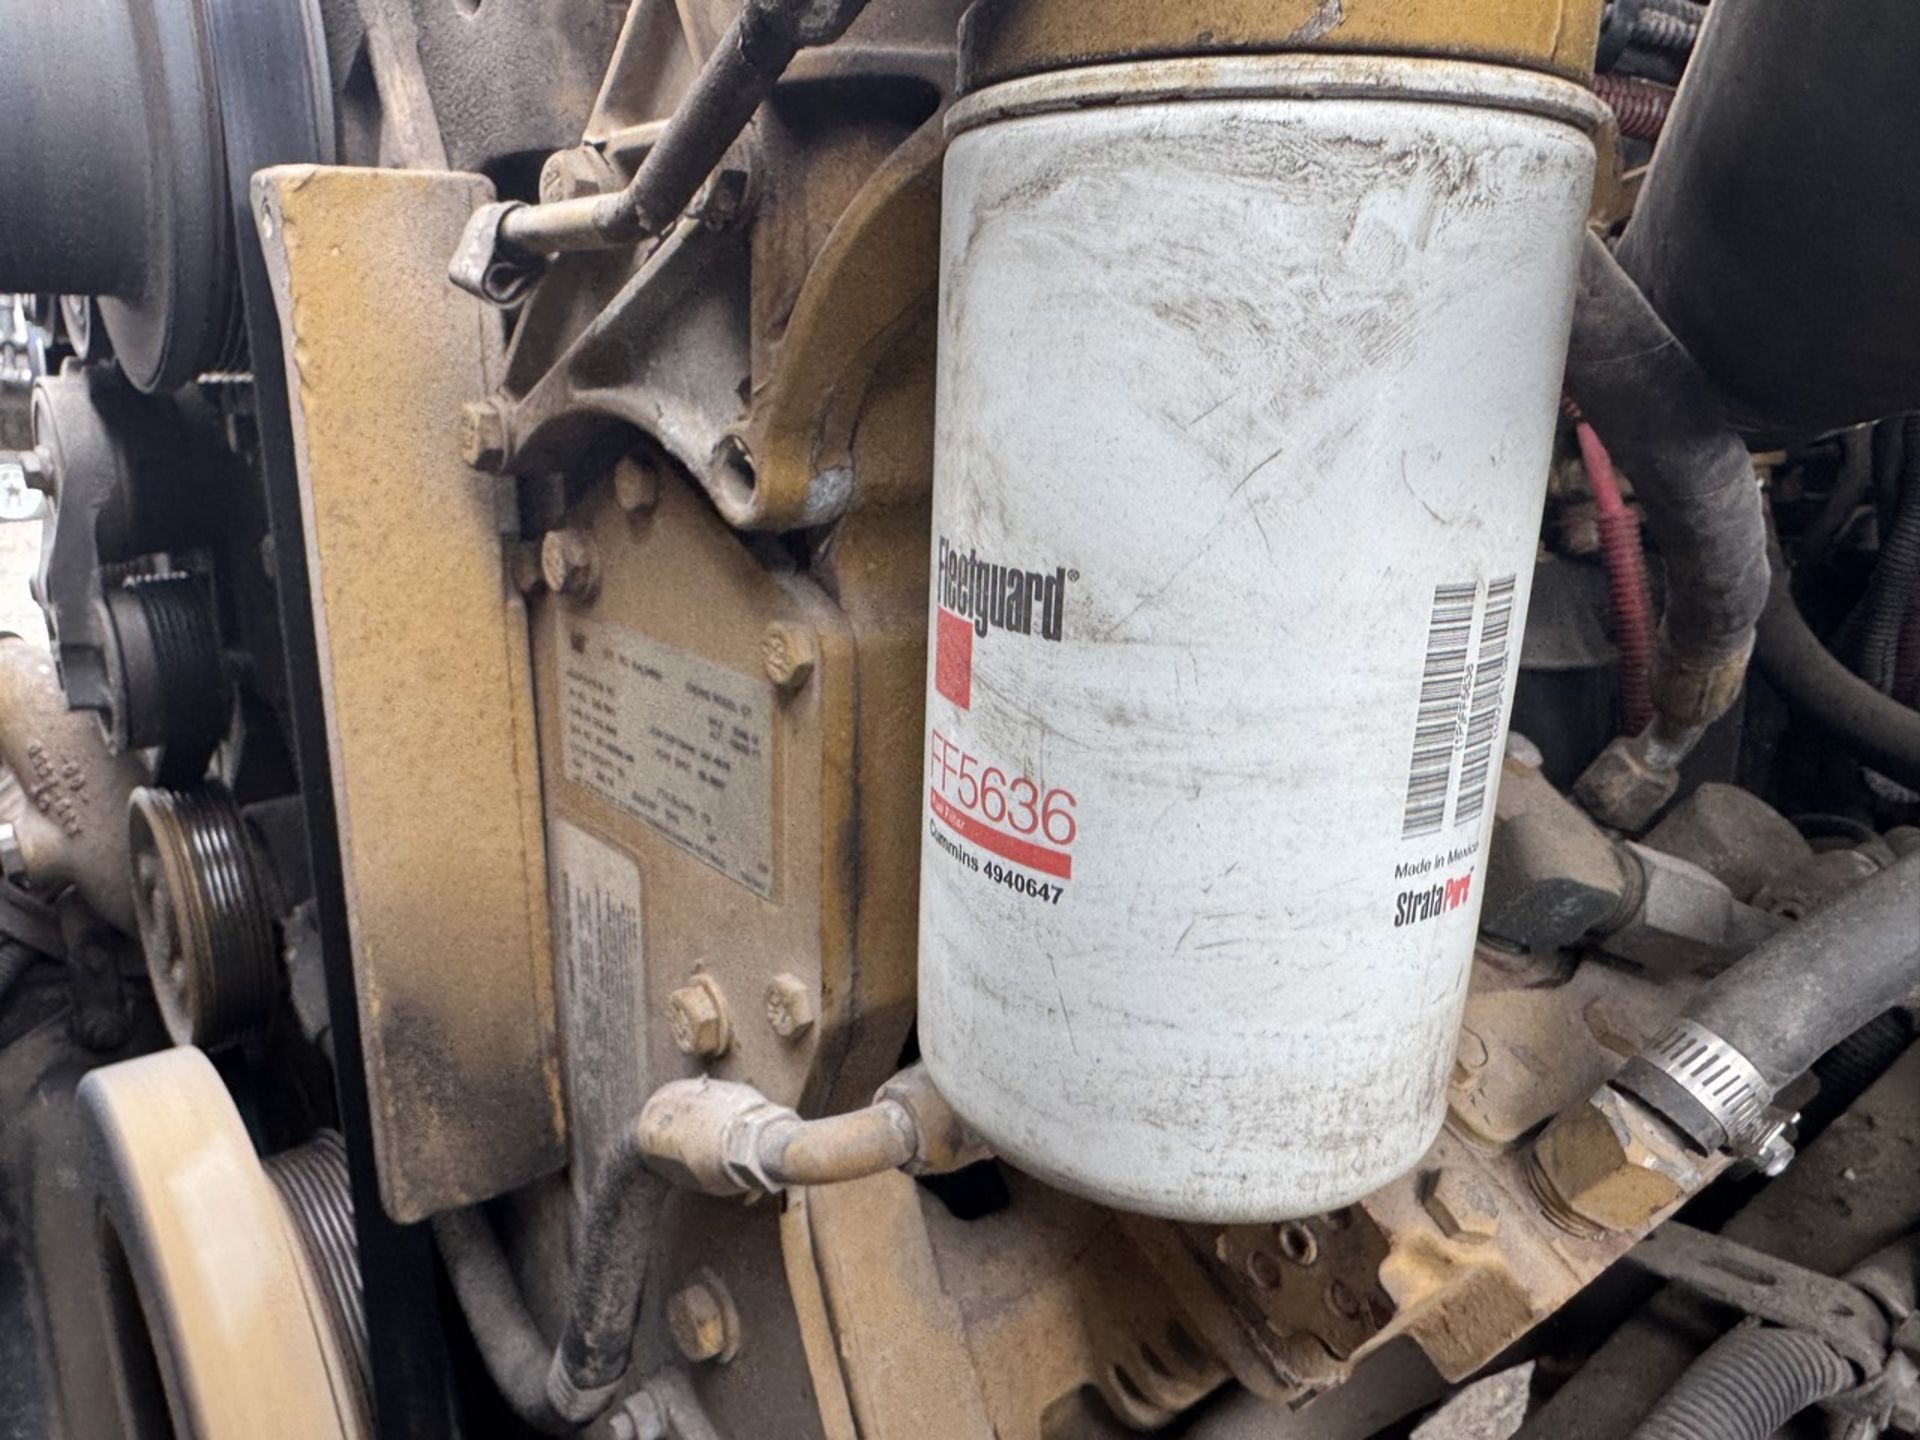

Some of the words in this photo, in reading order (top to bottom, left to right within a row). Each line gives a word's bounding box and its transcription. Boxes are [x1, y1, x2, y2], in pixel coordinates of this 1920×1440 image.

[931, 729, 1077, 846] FF5636
[929, 818, 979, 872] Cummins
[982, 861, 1064, 905] 4940647
[1394, 857, 1432, 880] Made
[1434, 853, 1445, 870] in
[1447, 840, 1479, 866] Mexico
